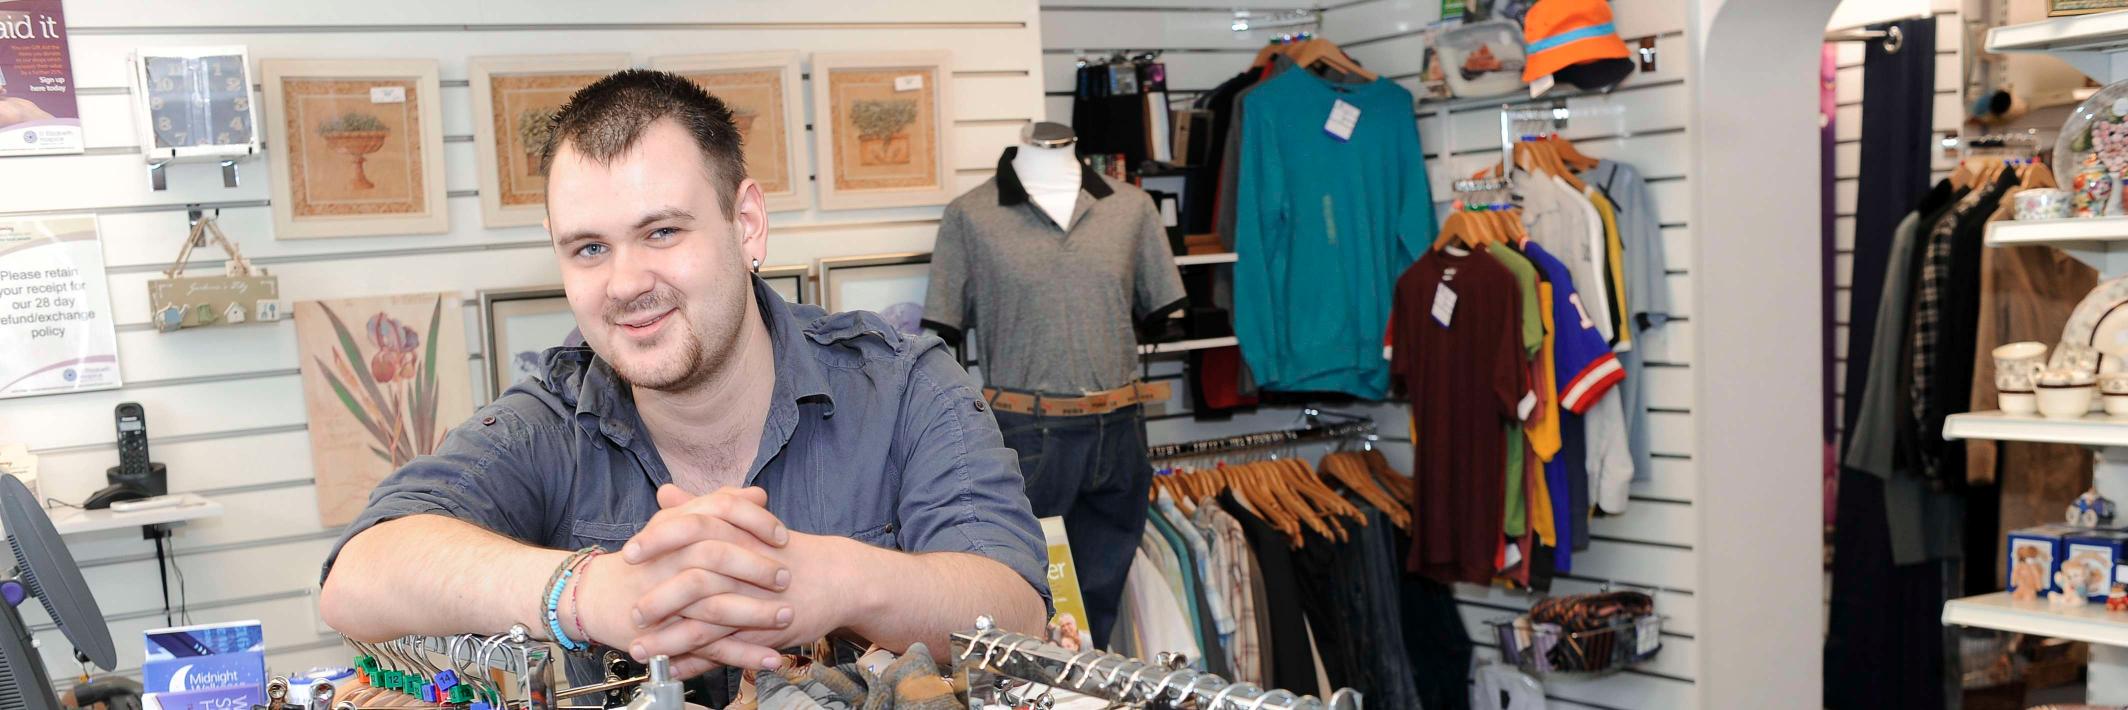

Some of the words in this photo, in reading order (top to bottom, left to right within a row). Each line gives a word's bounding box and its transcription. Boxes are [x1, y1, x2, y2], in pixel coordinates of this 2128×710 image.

[39, 14, 59, 38] it
[39, 76, 54, 84] Sign
[46, 85, 66, 93] today
[0, 270, 41, 280] Please
[45, 267, 79, 278] retain
[0, 286, 23, 299] your
[27, 282, 67, 294] receipt
[70, 280, 86, 291] for
[12, 300, 31, 310] our
[35, 297, 50, 308] 28
[54, 296, 75, 308] day
[0, 310, 95, 325] efund/exchange
[31, 326, 65, 340] policy
[189, 669, 238, 684] Midnight
[388, 675, 399, 684] 12
[440, 674, 450, 684] 14
